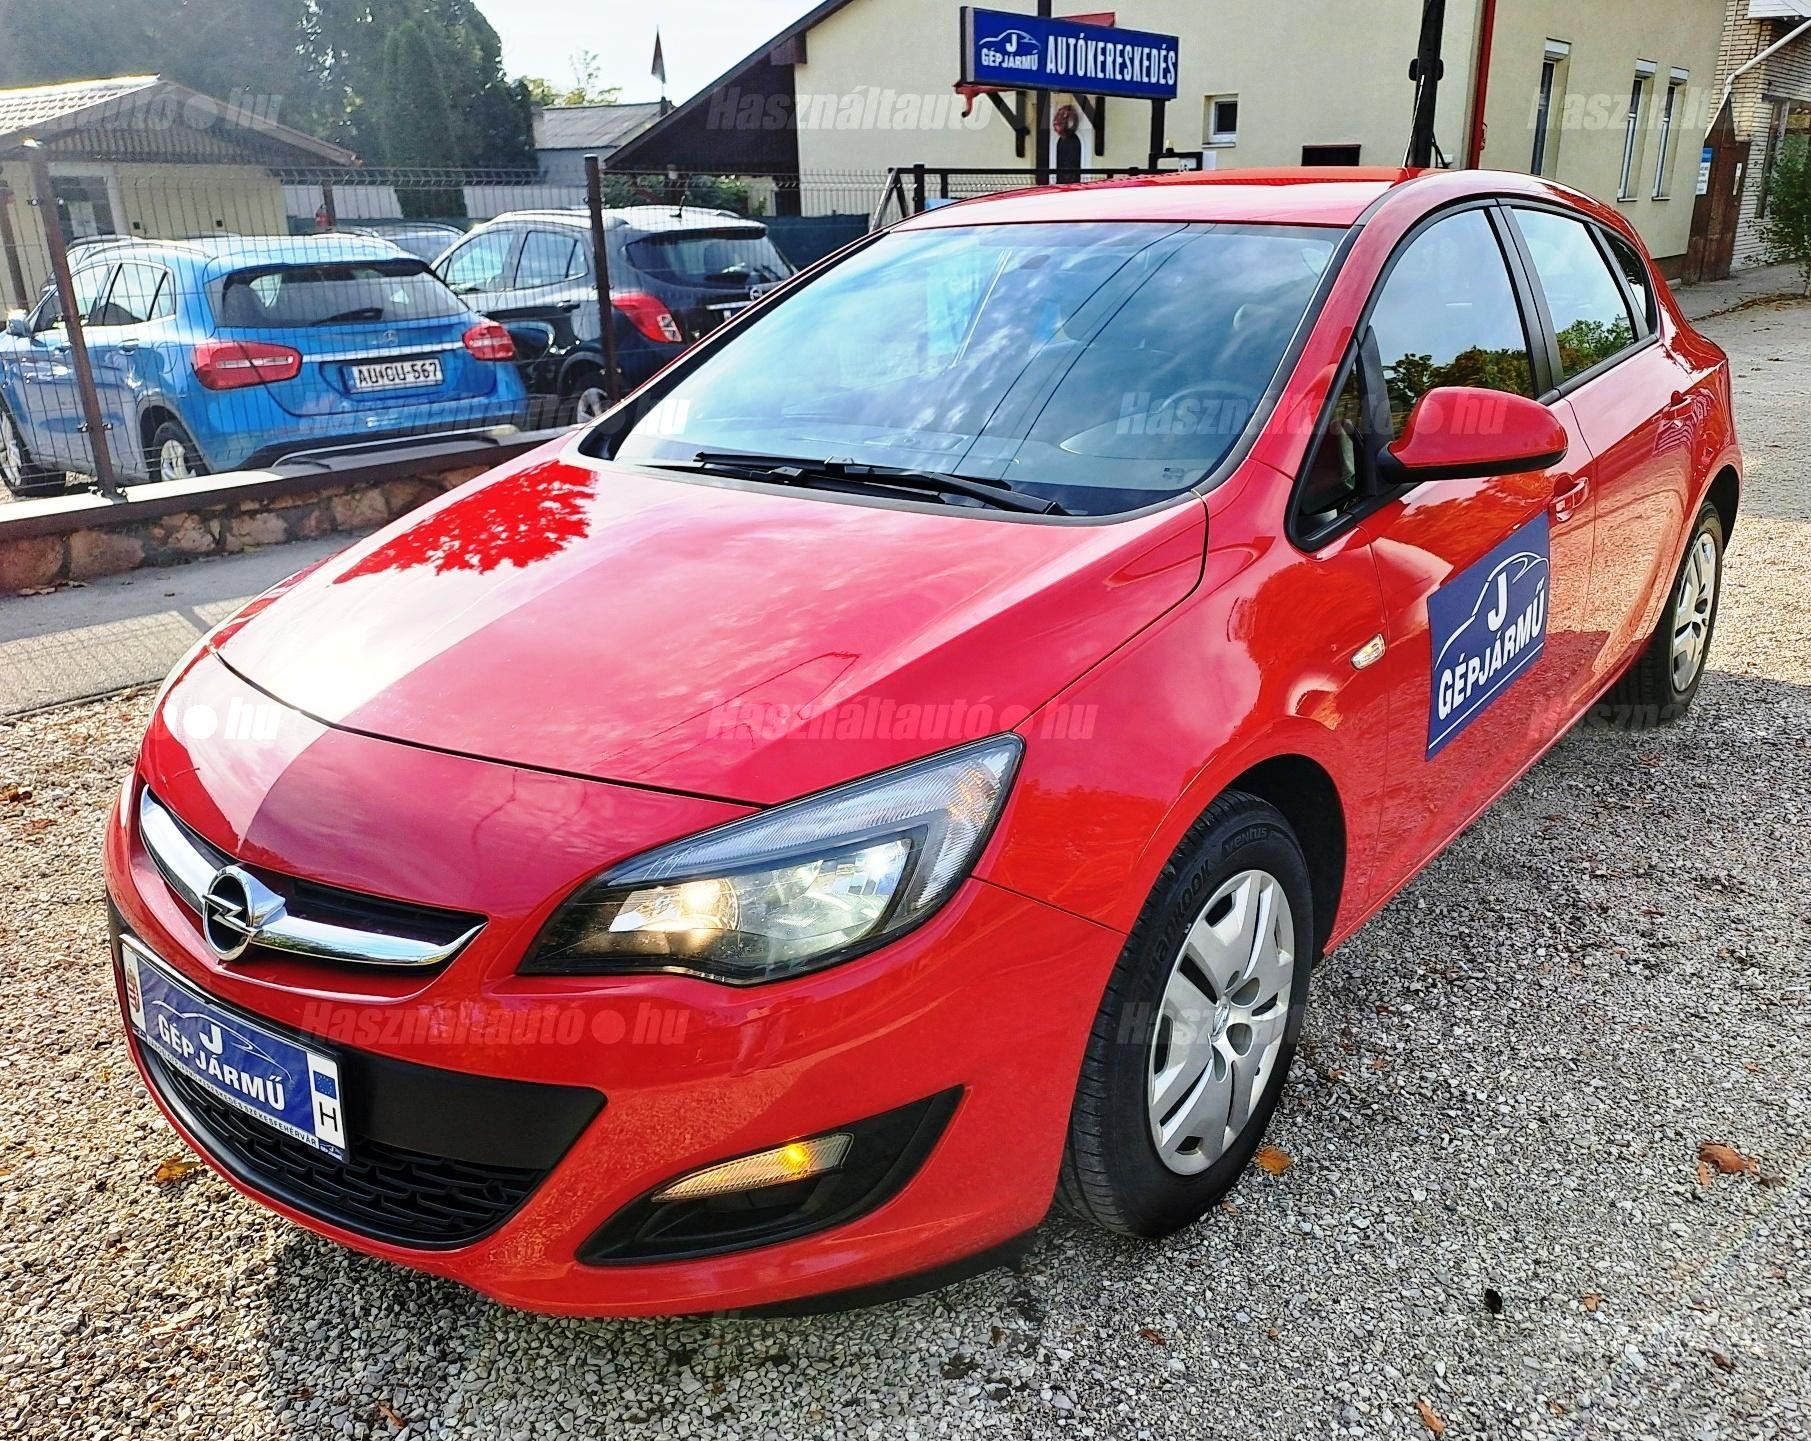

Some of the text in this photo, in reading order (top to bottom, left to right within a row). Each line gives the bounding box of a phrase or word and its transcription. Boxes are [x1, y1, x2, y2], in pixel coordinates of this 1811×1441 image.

[1005, 33, 1018, 53] J
[1046, 33, 1176, 86] AUTÓKERESKEDÉS
[1488, 571, 1508, 632] J
[1438, 576, 1545, 720] GÉPJÁRMŰ
[158, 1013, 285, 1112] GÉPJÁRMŰ
[199, 1023, 224, 1055] J
[319, 1101, 338, 1133] H
